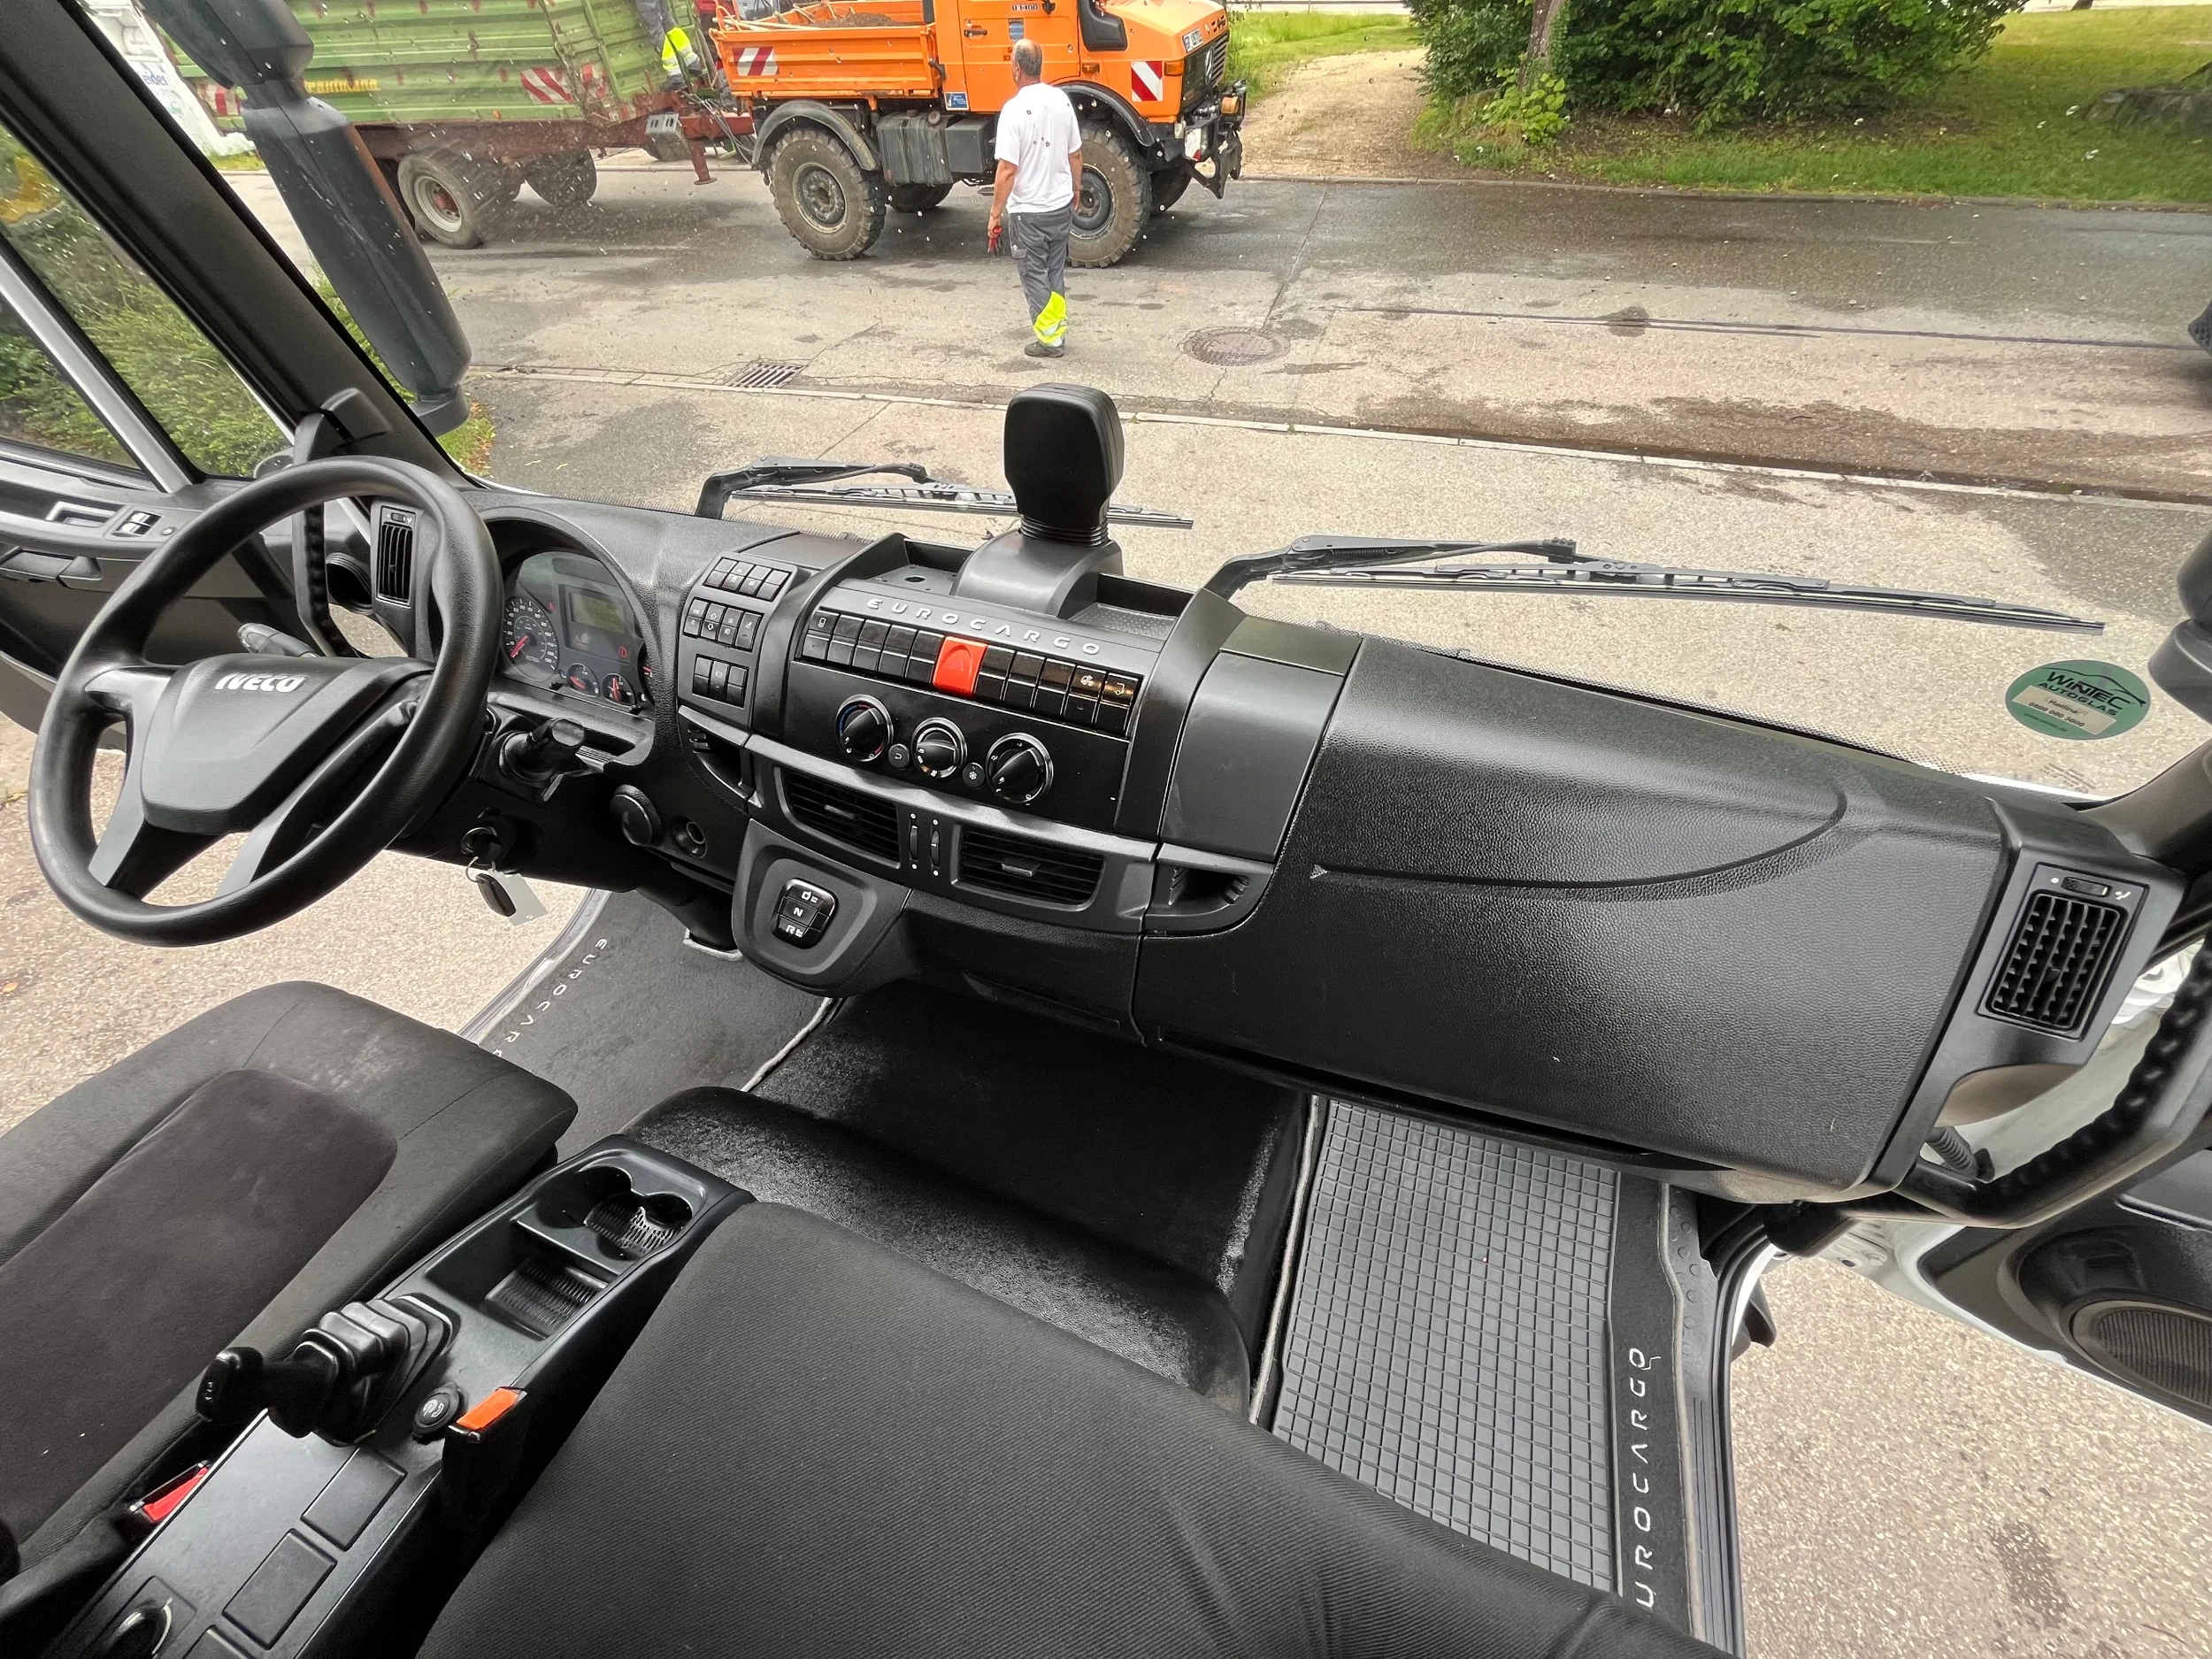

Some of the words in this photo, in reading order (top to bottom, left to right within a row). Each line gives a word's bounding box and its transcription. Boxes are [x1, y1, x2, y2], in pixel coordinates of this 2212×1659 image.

[304, 79, 379, 94] rautmann
[867, 598, 1101, 655] EUROCARGO
[214, 672, 308, 693] IVECO
[2038, 682, 2118, 716] AUTOGLAS
[793, 907, 803, 917] N
[1629, 1348, 1655, 1609] UROCARGO
